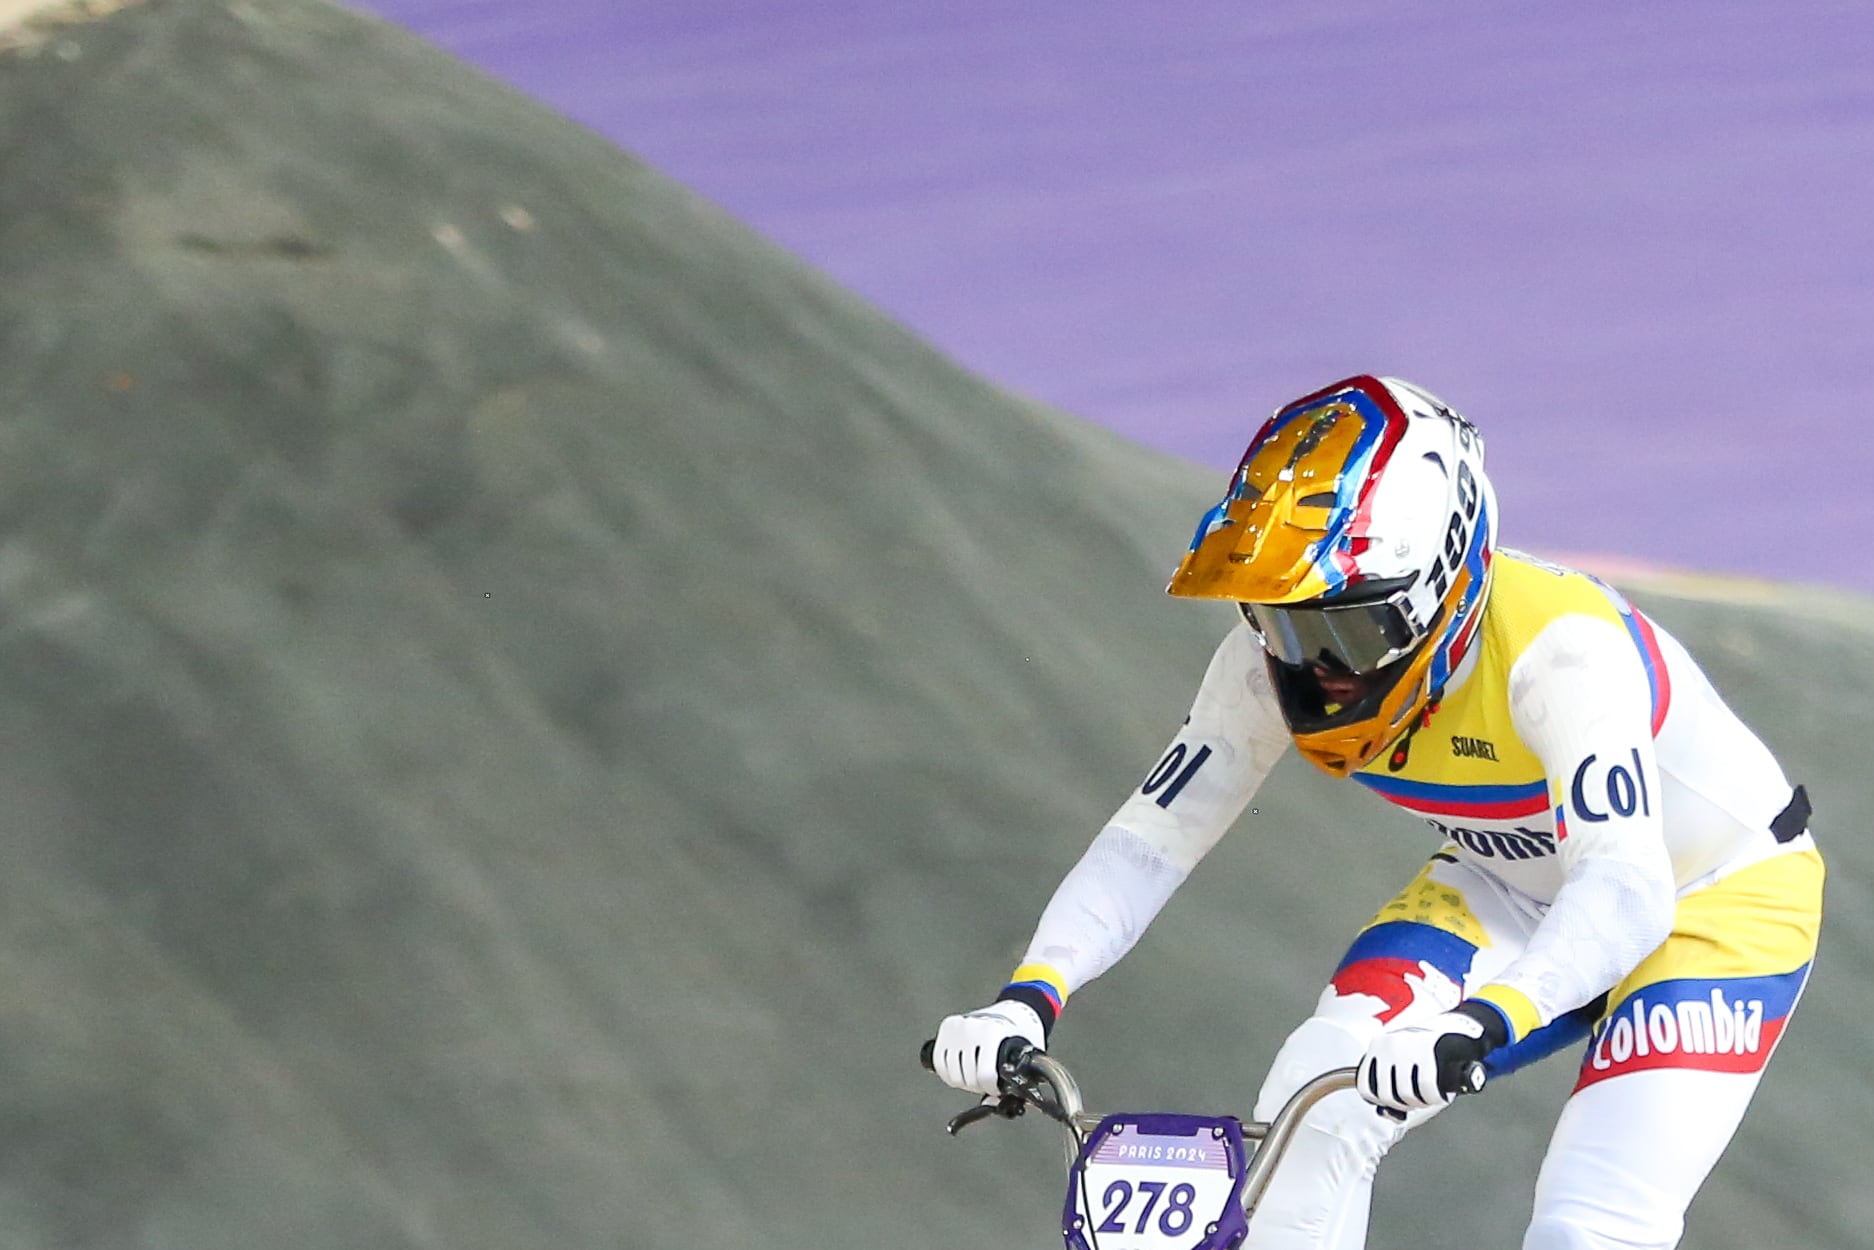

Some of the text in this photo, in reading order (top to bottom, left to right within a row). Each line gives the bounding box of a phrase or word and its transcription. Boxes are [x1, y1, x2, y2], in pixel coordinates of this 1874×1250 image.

[1142, 715, 1212, 809] ol
[1451, 736, 1499, 762] SUAREZ
[1571, 748, 1650, 822] Col
[1592, 987, 1763, 1070] Colombia
[1118, 1145, 1207, 1162] PARIS 2024
[1096, 1179, 1196, 1237] 278
